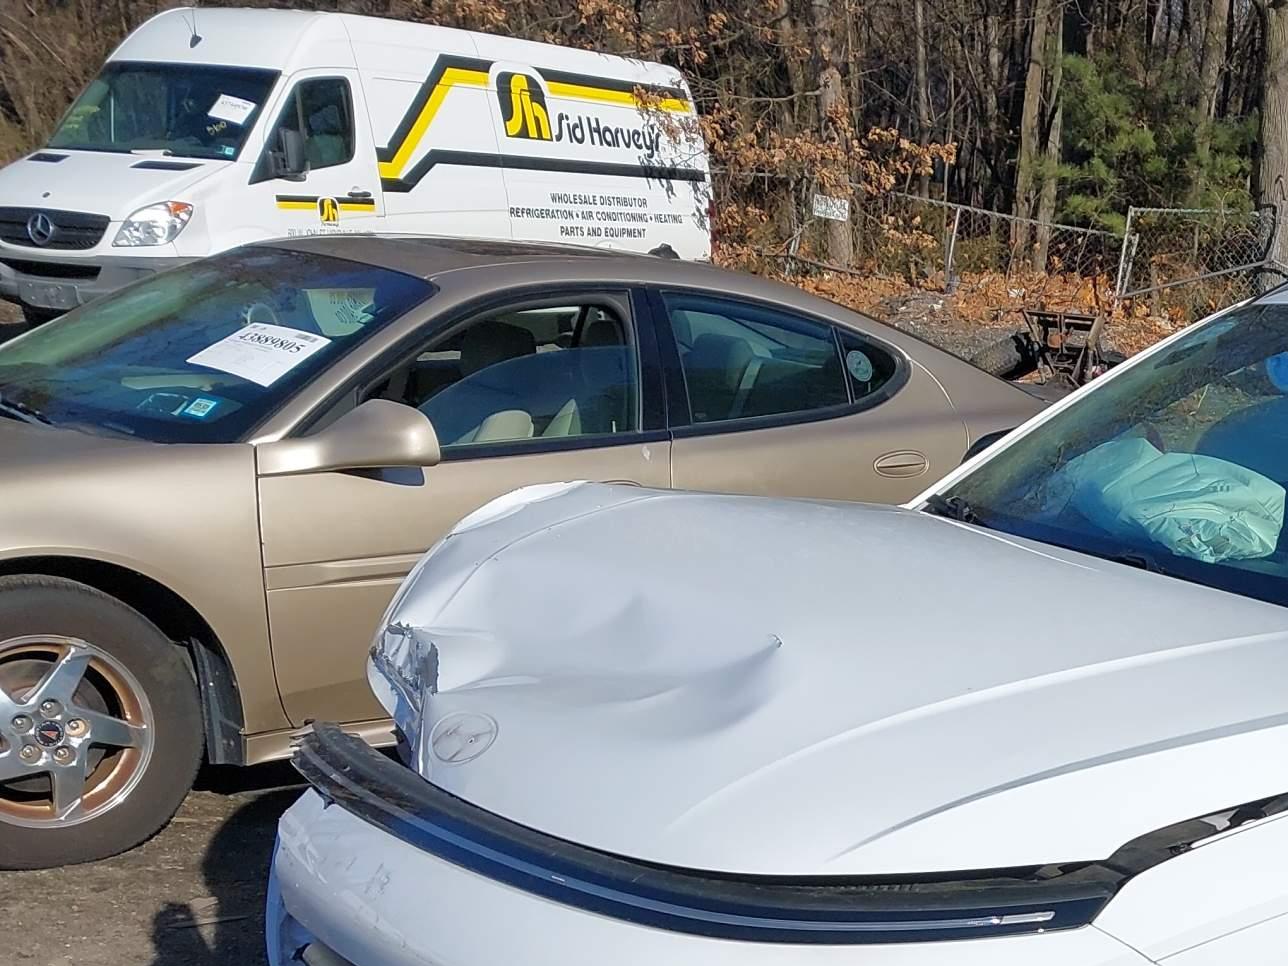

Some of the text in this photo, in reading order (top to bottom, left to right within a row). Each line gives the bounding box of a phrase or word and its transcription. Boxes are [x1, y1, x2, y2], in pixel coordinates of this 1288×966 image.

[554, 112, 585, 144] Sid
[550, 192, 648, 209] WHOLESALE DISTRIBUTOR
[509, 206, 683, 224] REFRIGERATION AIR CONDITIONING HEATING
[560, 225, 647, 239] PARTS AND EQUIPMENT
[238, 331, 308, 354] 43889805
